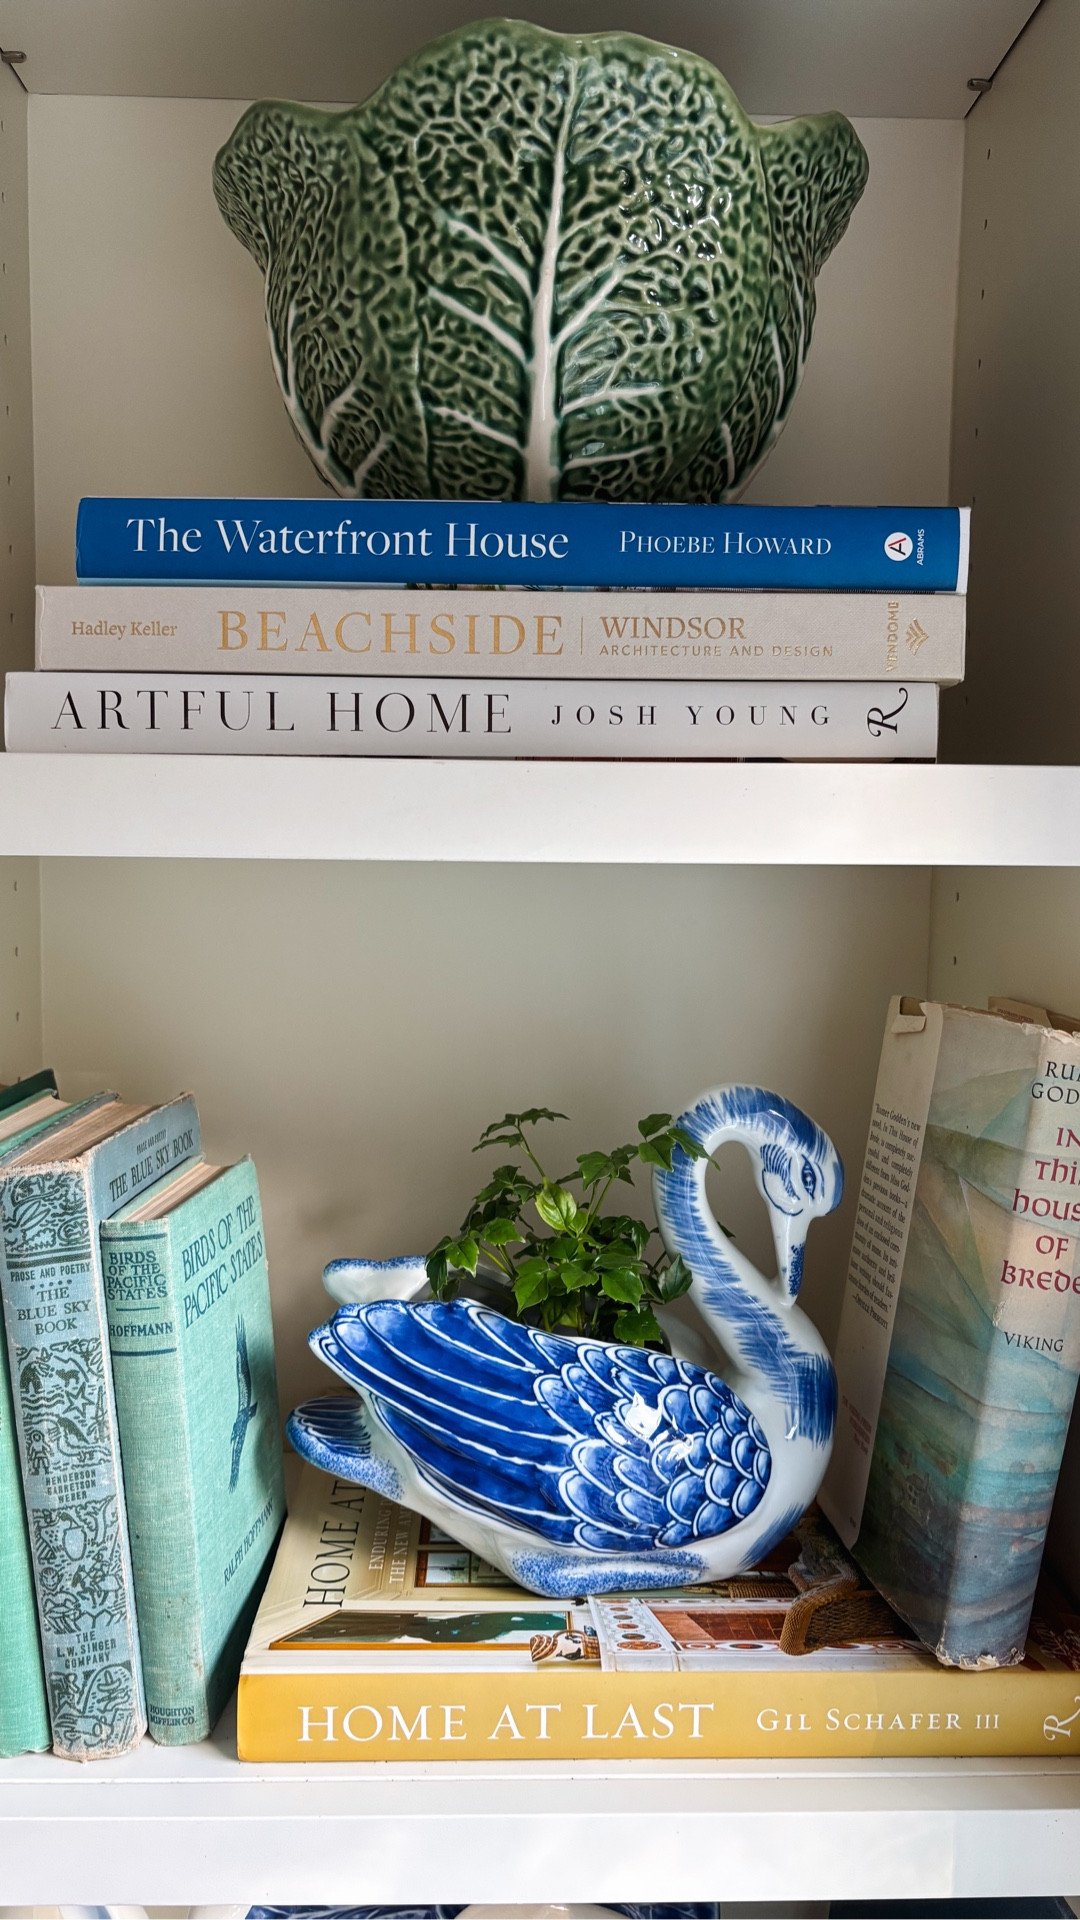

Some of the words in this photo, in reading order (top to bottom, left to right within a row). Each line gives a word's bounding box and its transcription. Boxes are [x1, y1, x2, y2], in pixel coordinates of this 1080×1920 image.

[126, 518, 202, 553] The
[214, 519, 433, 557] Waterfront
[445, 521, 569, 560] House
[619, 530, 715, 555] PHOEBE
[722, 531, 832, 556] HOWARD
[916, 528, 925, 566] ABRAMS
[71, 621, 127, 640] Hadley
[130, 622, 178, 637] Keller
[217, 610, 564, 656] BEACHSIDE
[600, 616, 746, 640] WINDSOR
[885, 600, 900, 672] VENDOME
[600, 644, 722, 657] ARCHITECTURE
[729, 645, 764, 657] AND
[772, 645, 833, 658] DESIGN
[51, 690, 295, 732] ARTFUL
[327, 692, 512, 733] HOME
[551, 705, 657, 726] JOSH
[686, 704, 831, 726] YOUNG
[866, 687, 908, 738] R
[889, 1110, 910, 1127] Godden's
[910, 1121, 920, 1131] new
[912, 1137, 918, 1148] of
[1056, 1127, 1080, 1148] IN
[884, 1141, 905, 1159] completely
[109, 1172, 128, 1202] THE
[131, 1156, 153, 1188] BLUE
[155, 1144, 170, 1170] SKY
[173, 1128, 194, 1158] BOOK
[891, 1160, 913, 1178] completely
[874, 1214, 883, 1225] and
[891, 1208, 897, 1218] of
[897, 1211, 905, 1223] the
[182, 1228, 216, 1283] BIRDS
[218, 1213, 233, 1250] OF
[236, 1195, 257, 1235] THE
[1035, 1234, 1069, 1261] OF
[109, 1251, 157, 1265] BIRDS
[10, 1270, 36, 1282] PROSE
[40, 1267, 55, 1279] AND
[60, 1262, 91, 1276] POETRY
[109, 1265, 127, 1276] OF
[131, 1263, 161, 1275] THE
[183, 1262, 229, 1329] PACIFIC
[230, 1231, 263, 1284] STATES
[107, 1273, 167, 1289] PACIFIC
[37, 1287, 69, 1302] THE
[107, 1286, 168, 1301] STATES
[16, 1305, 57, 1320] BLUE
[64, 1299, 91, 1314] SKY
[35, 1318, 77, 1335] BOOK
[109, 1322, 174, 1337] HOFFMANN
[1004, 1331, 1064, 1352] VIKING
[45, 1469, 96, 1486] HENDERSON
[58, 1490, 87, 1504] WEBER
[329, 1480, 367, 1513] AT
[368, 1509, 392, 1570] ENDURING
[393, 1530, 409, 1555] NEW
[223, 1544, 244, 1587] RALPH
[303, 1520, 360, 1608] HOME
[389, 1559, 406, 1584] THE
[76, 1631, 96, 1643] THE
[80, 1638, 116, 1654] SINGER
[65, 1651, 110, 1669] COMPANY
[297, 1704, 467, 1742] HOME
[487, 1703, 562, 1741] AT
[582, 1701, 715, 1740] LAST
[756, 1708, 811, 1731] GIL
[826, 1708, 963, 1731] SCHAFER
[975, 1714, 1000, 1730] III
[1043, 1696, 1080, 1741] R
